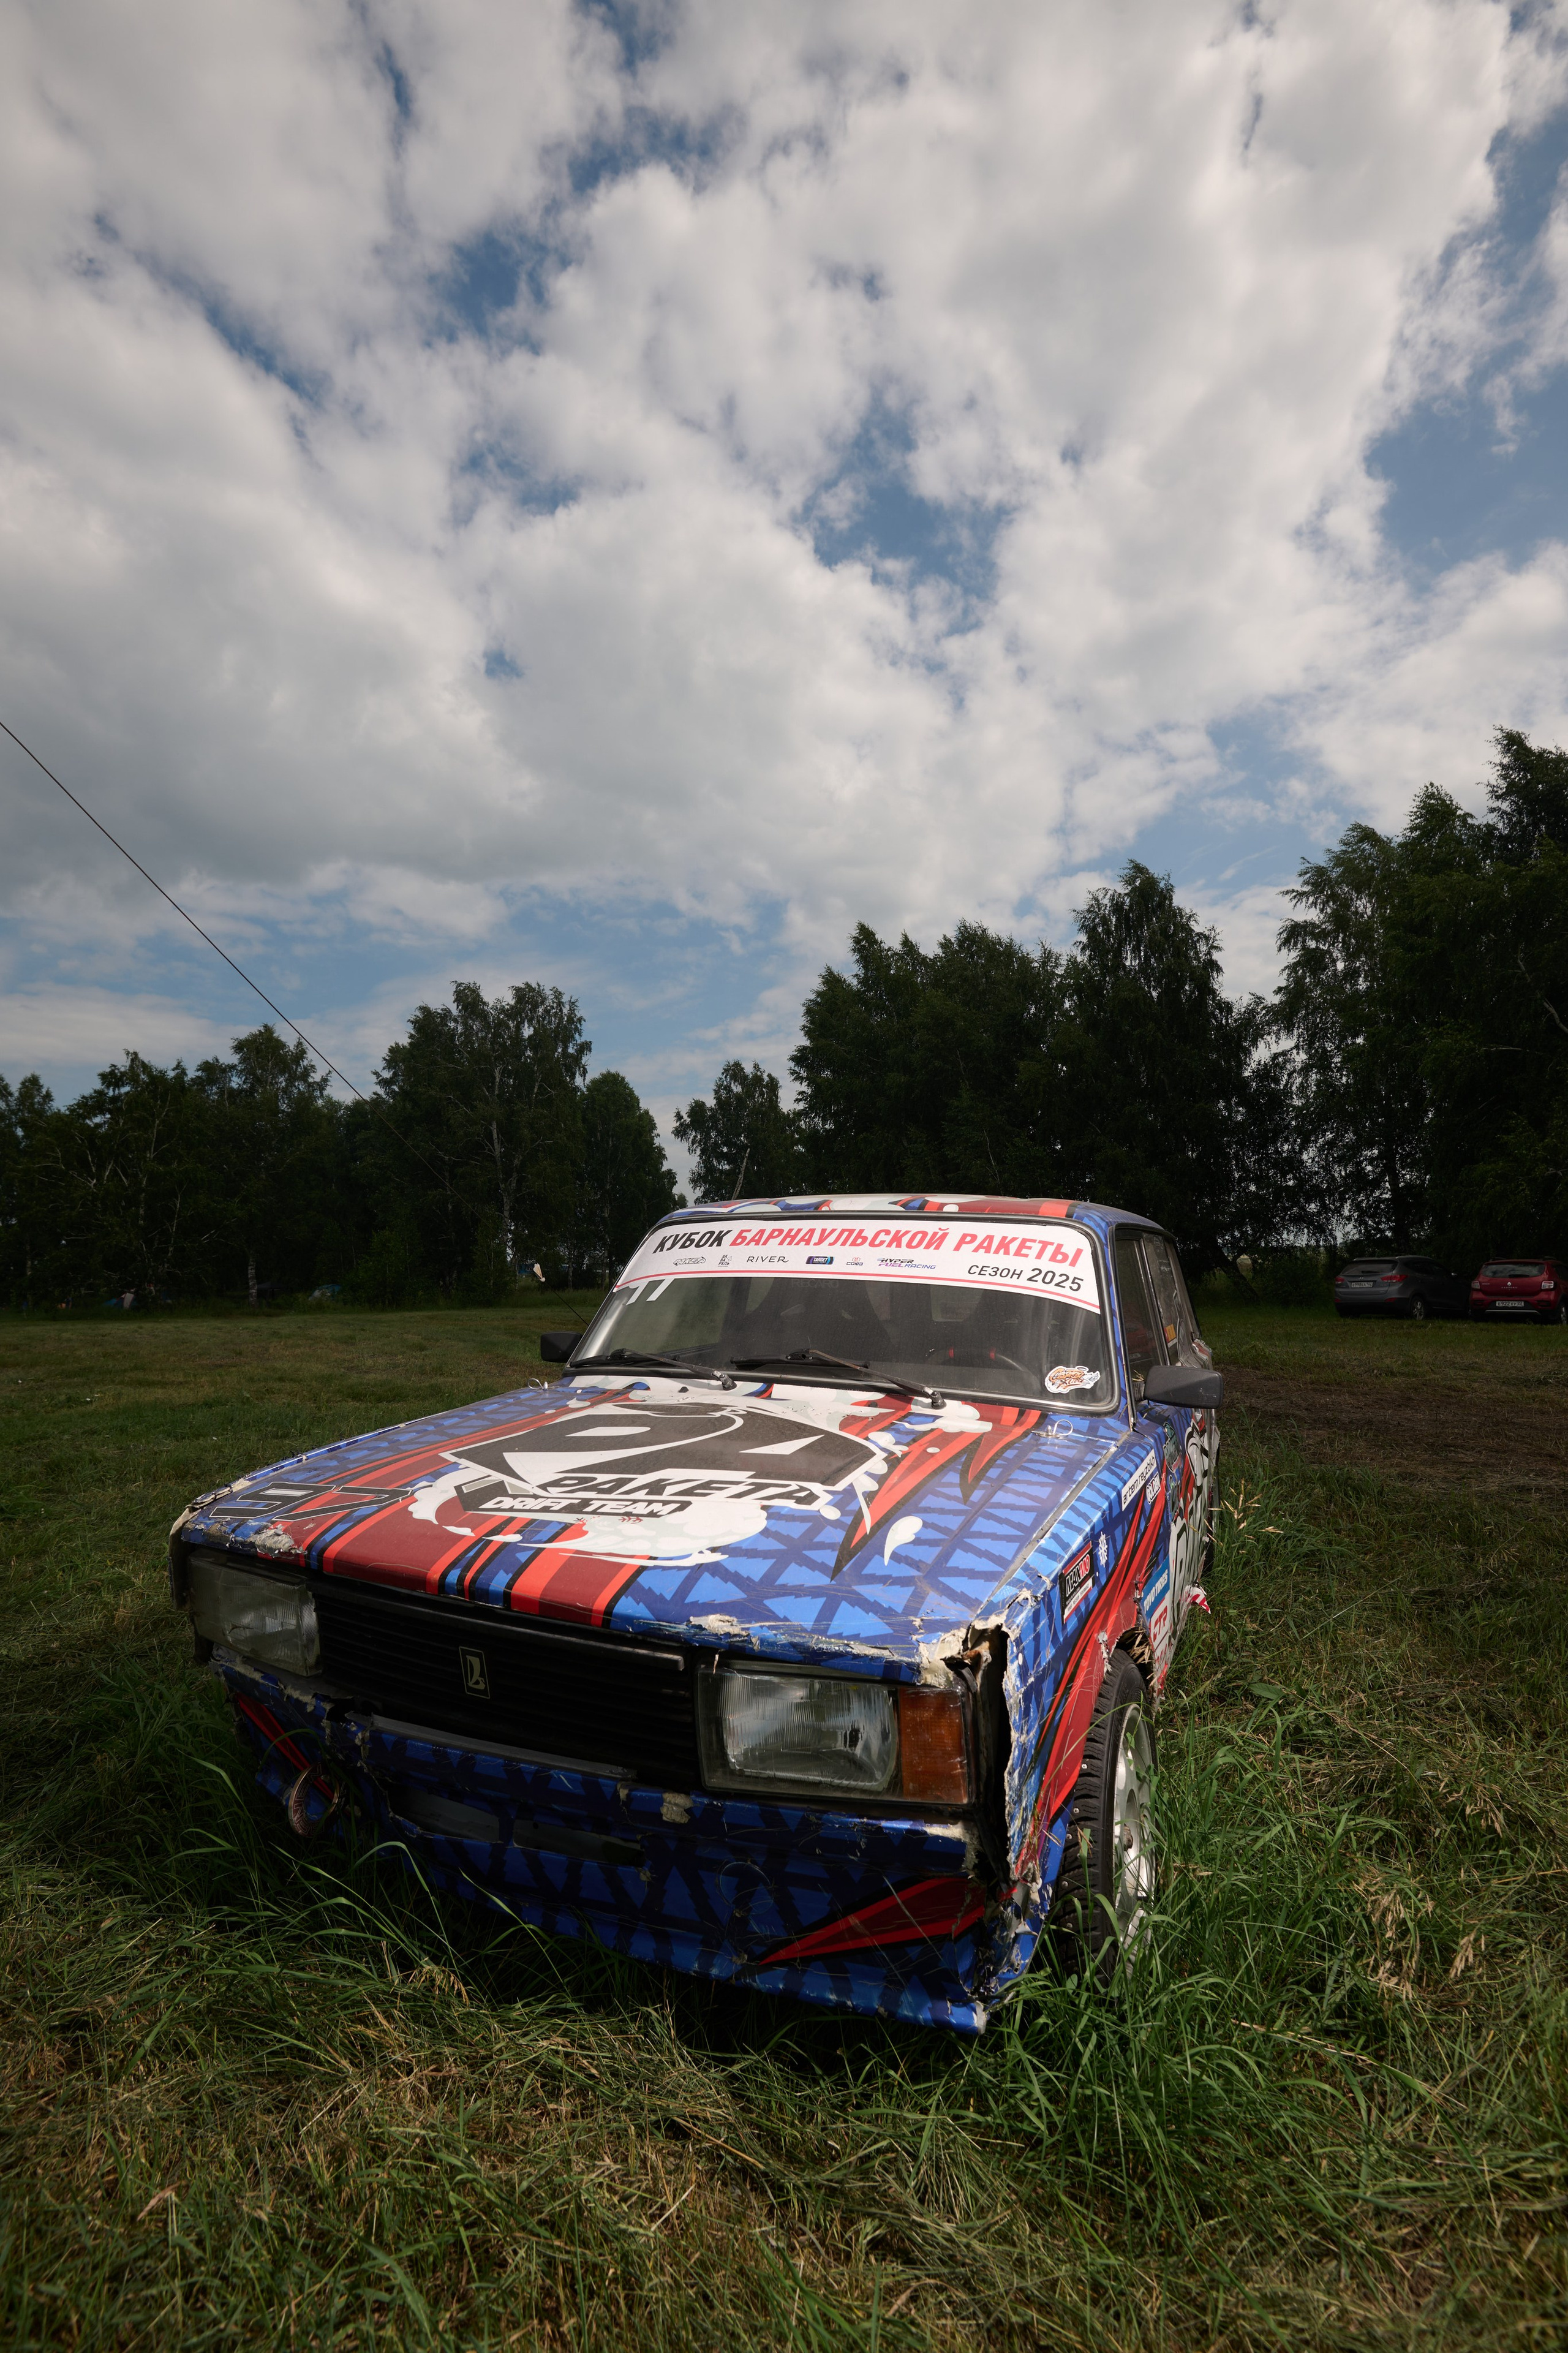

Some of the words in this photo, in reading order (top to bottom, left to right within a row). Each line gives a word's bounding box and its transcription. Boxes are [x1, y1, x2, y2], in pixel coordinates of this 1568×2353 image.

[652, 1229, 732, 1254] КУБОК
[729, 1228, 951, 1251] БАРНАУЛЬСКОЙ
[952, 1233, 1084, 1267] РАКЕТЫ
[968, 1264, 1023, 1281] СЕЗОН
[1026, 1268, 1084, 1292] 2025
[1123, 1478, 1139, 1505] artem
[480, 1497, 584, 1511] DRIFT
[582, 1500, 684, 1516] TEAM
[1144, 1586, 1155, 1614] TOYO
[1155, 1569, 1168, 1597] TIRES
